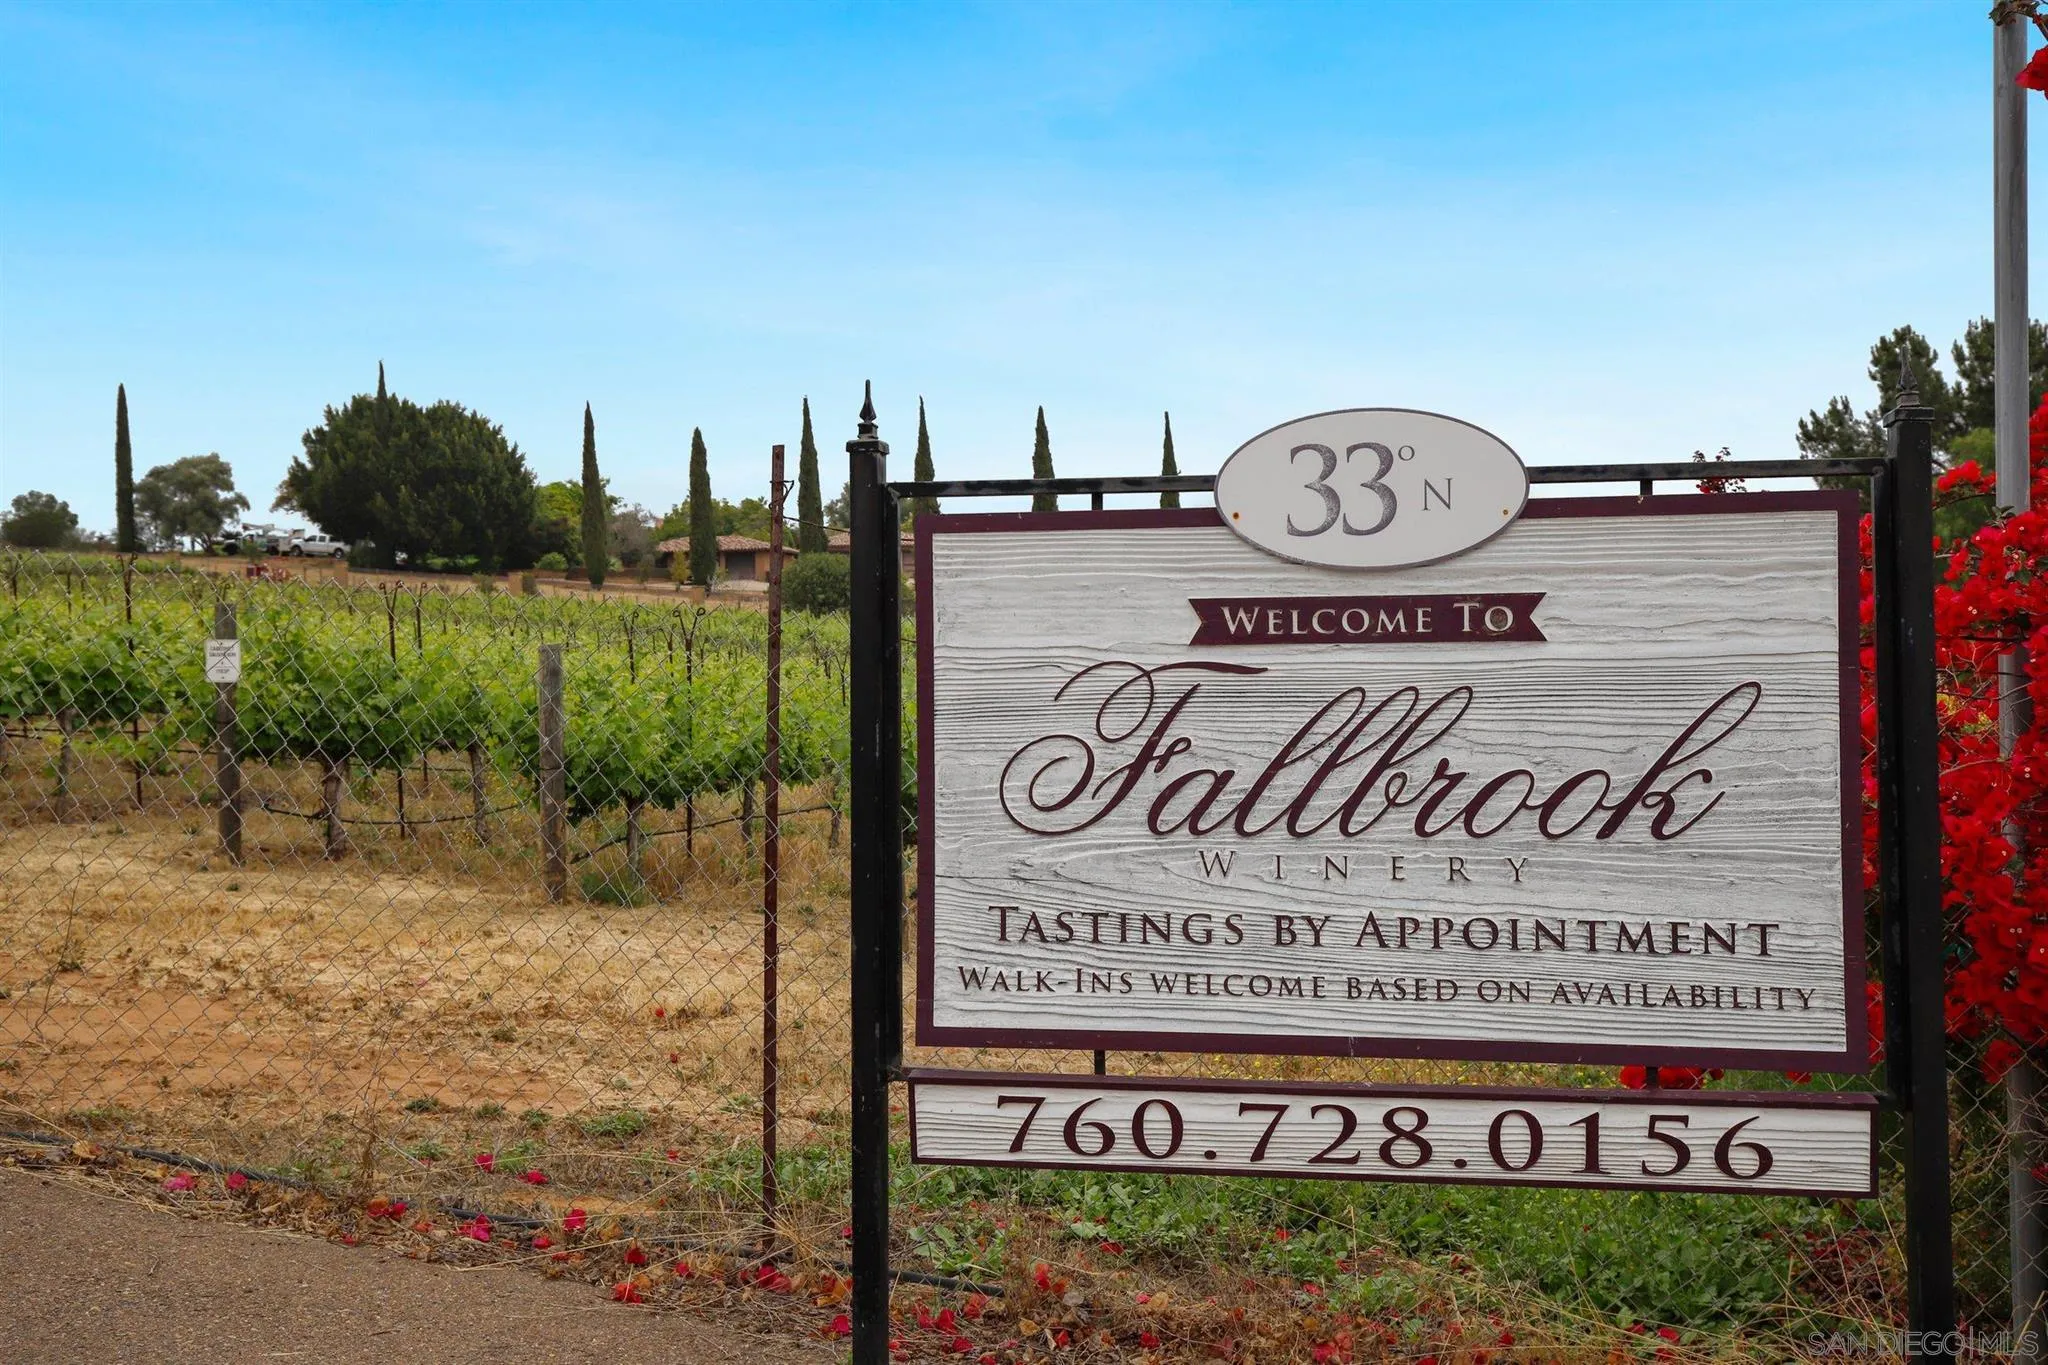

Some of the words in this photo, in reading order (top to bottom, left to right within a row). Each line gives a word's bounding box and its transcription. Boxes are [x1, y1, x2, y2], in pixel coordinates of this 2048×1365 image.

[1422, 477, 1454, 512] N
[1220, 605, 1433, 635] WELCOME
[1453, 601, 1515, 633] TO
[999, 660, 1762, 840] Fallbrook
[1198, 849, 1529, 882] WINERY
[988, 905, 1245, 946] TASTINGS
[1273, 914, 1331, 948] BY
[1354, 910, 1780, 957] APPOINTMENT
[957, 965, 1134, 994] WALK-INS
[1149, 972, 1327, 999] WELCOME
[1346, 976, 1459, 1002] BASED
[1476, 979, 1531, 1003] ON
[1550, 981, 1817, 1011] AVAILABILITY
[997, 1095, 1774, 1181] 760.728.0156
